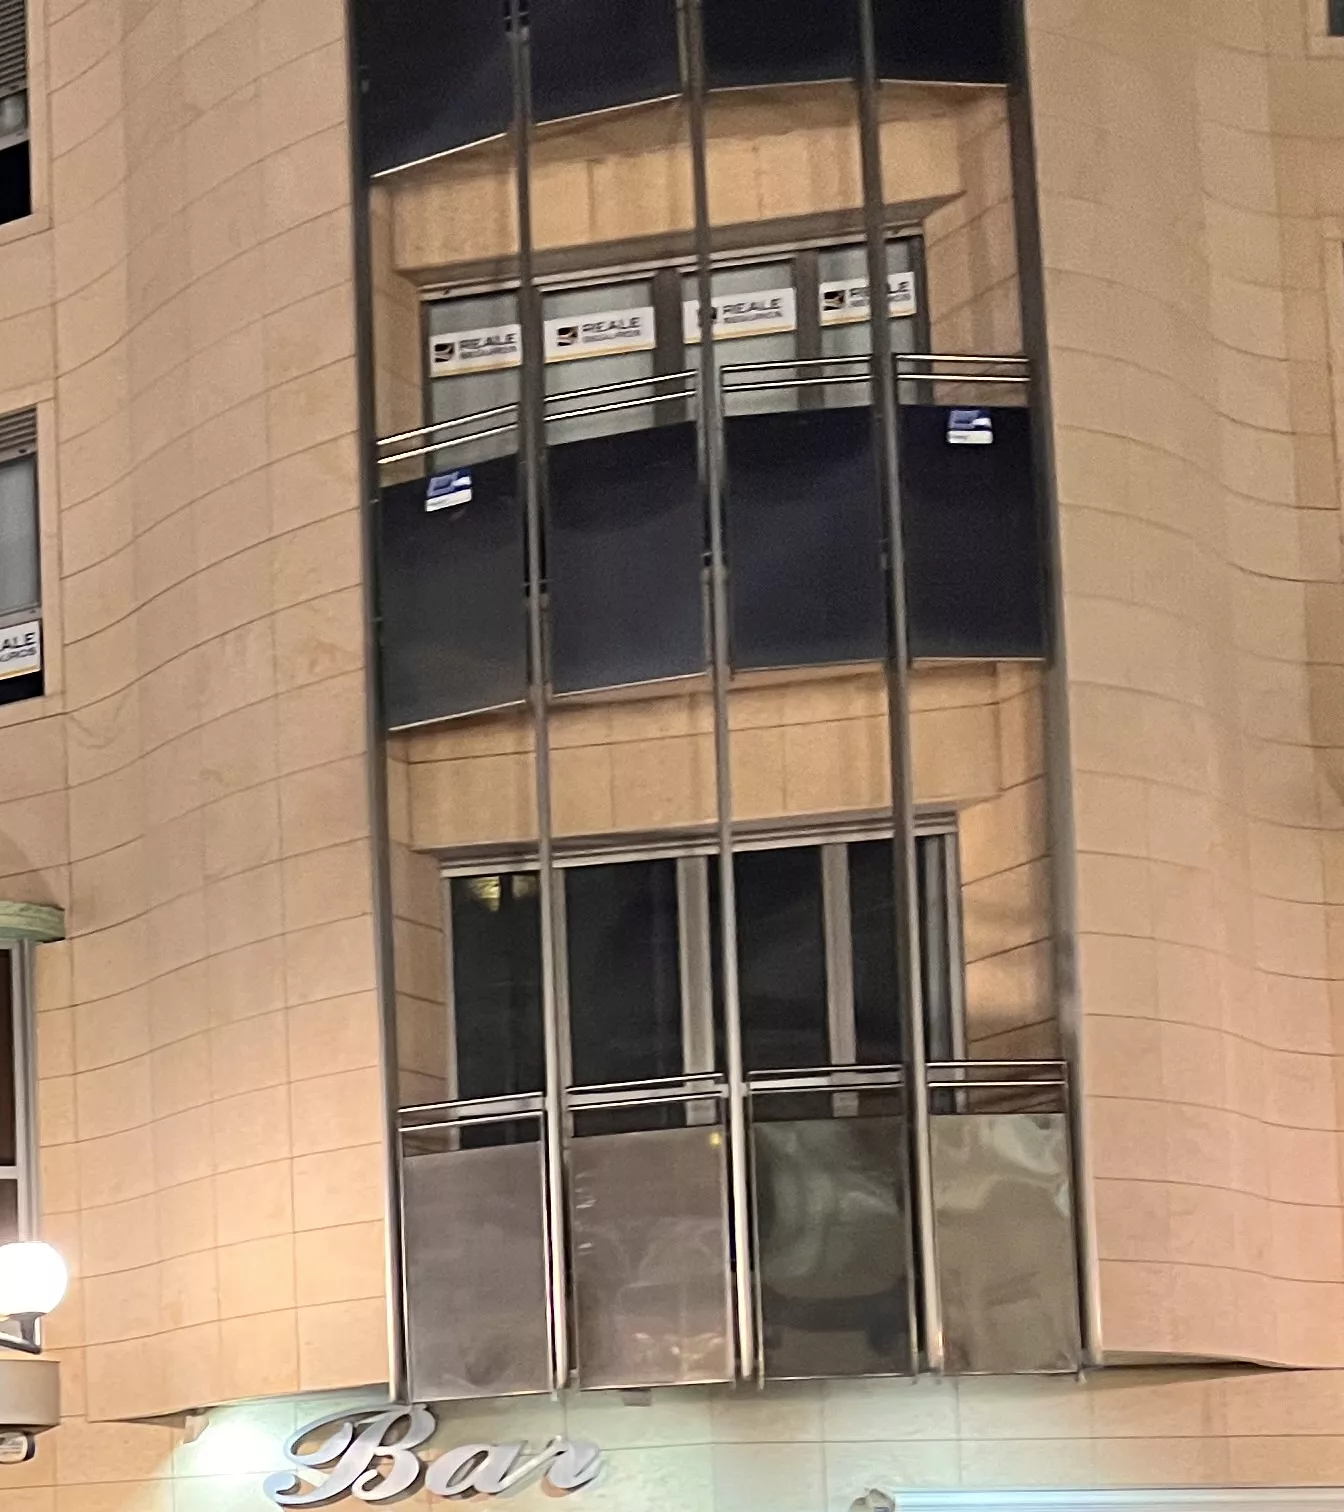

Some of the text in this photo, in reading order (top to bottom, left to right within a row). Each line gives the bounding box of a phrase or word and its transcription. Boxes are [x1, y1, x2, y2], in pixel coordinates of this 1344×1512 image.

[720, 296, 783, 317] REALE
[582, 315, 642, 336] REALE
[458, 332, 517, 351] REALE
[263, 1402, 608, 1507] Bar
